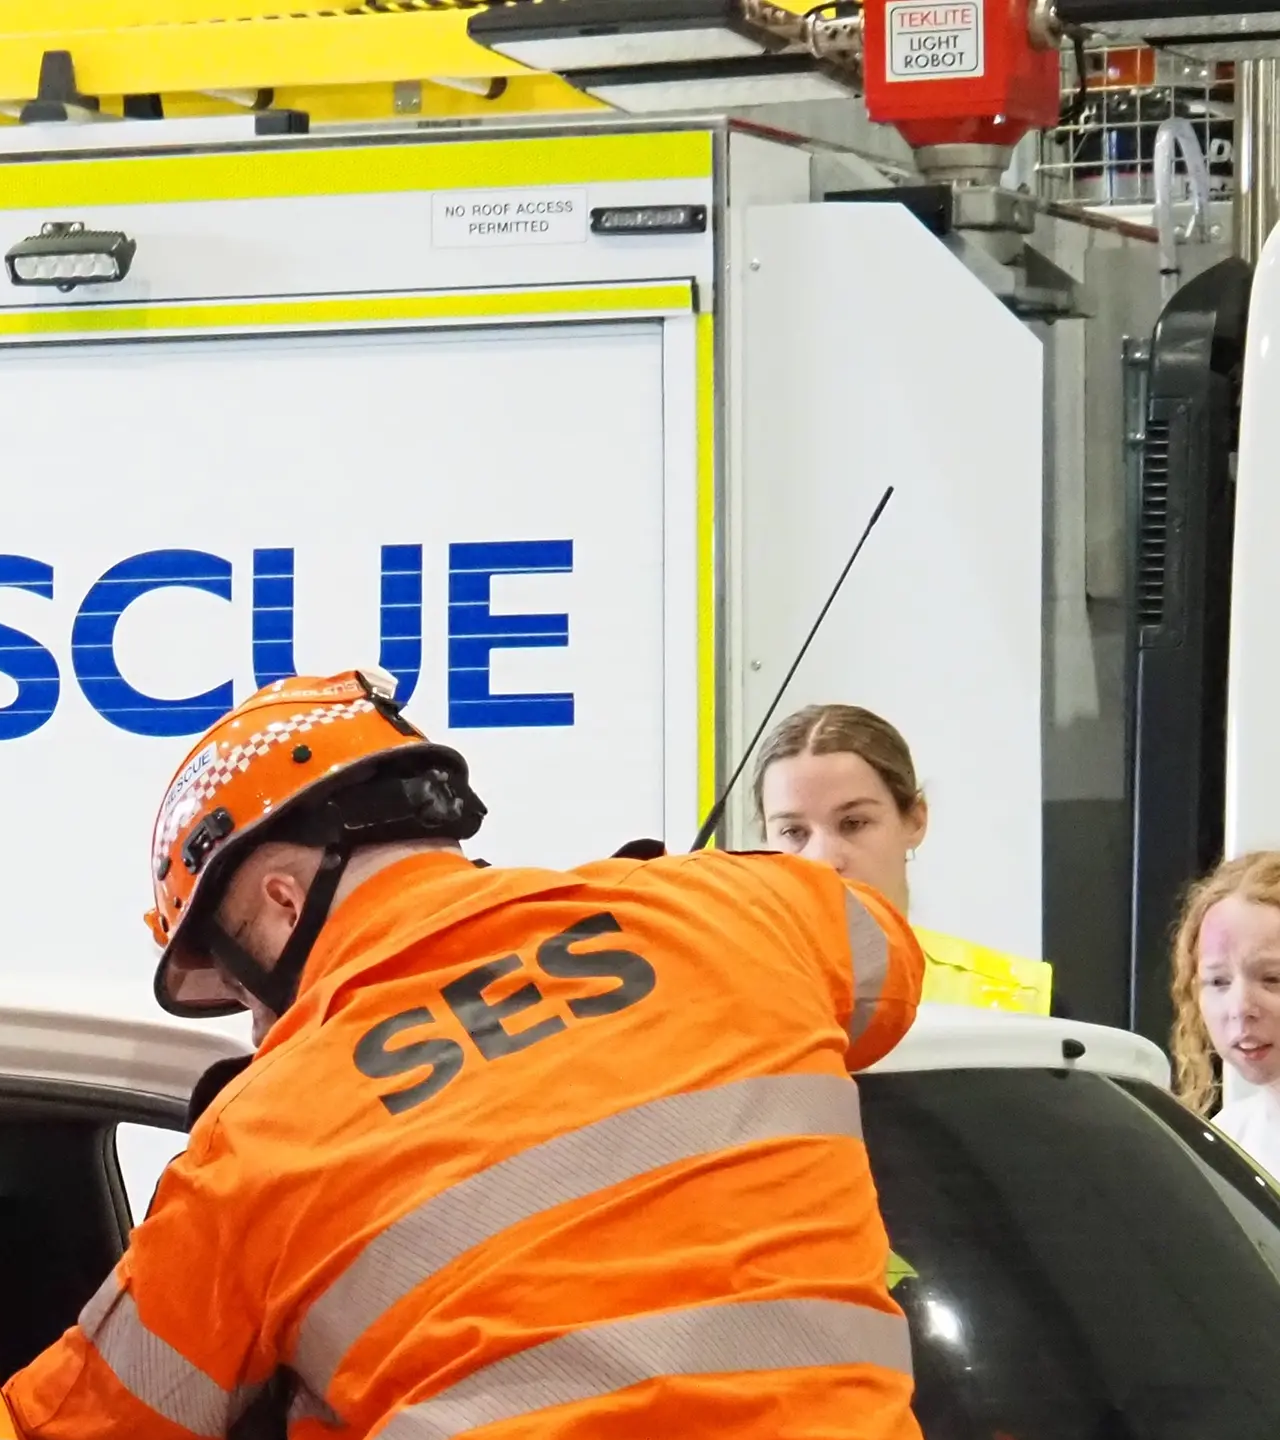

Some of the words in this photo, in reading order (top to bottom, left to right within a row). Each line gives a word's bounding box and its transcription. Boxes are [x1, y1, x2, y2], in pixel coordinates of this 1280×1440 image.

[897, 8, 972, 28] TEKLITE
[910, 34, 959, 52] LIGHT
[904, 51, 965, 69] ROBOT
[444, 205, 465, 218] NO
[472, 203, 511, 217] ROOF
[516, 200, 574, 215] ACCESS
[468, 220, 549, 236] PERMITTED
[352, 911, 656, 1116] SES
